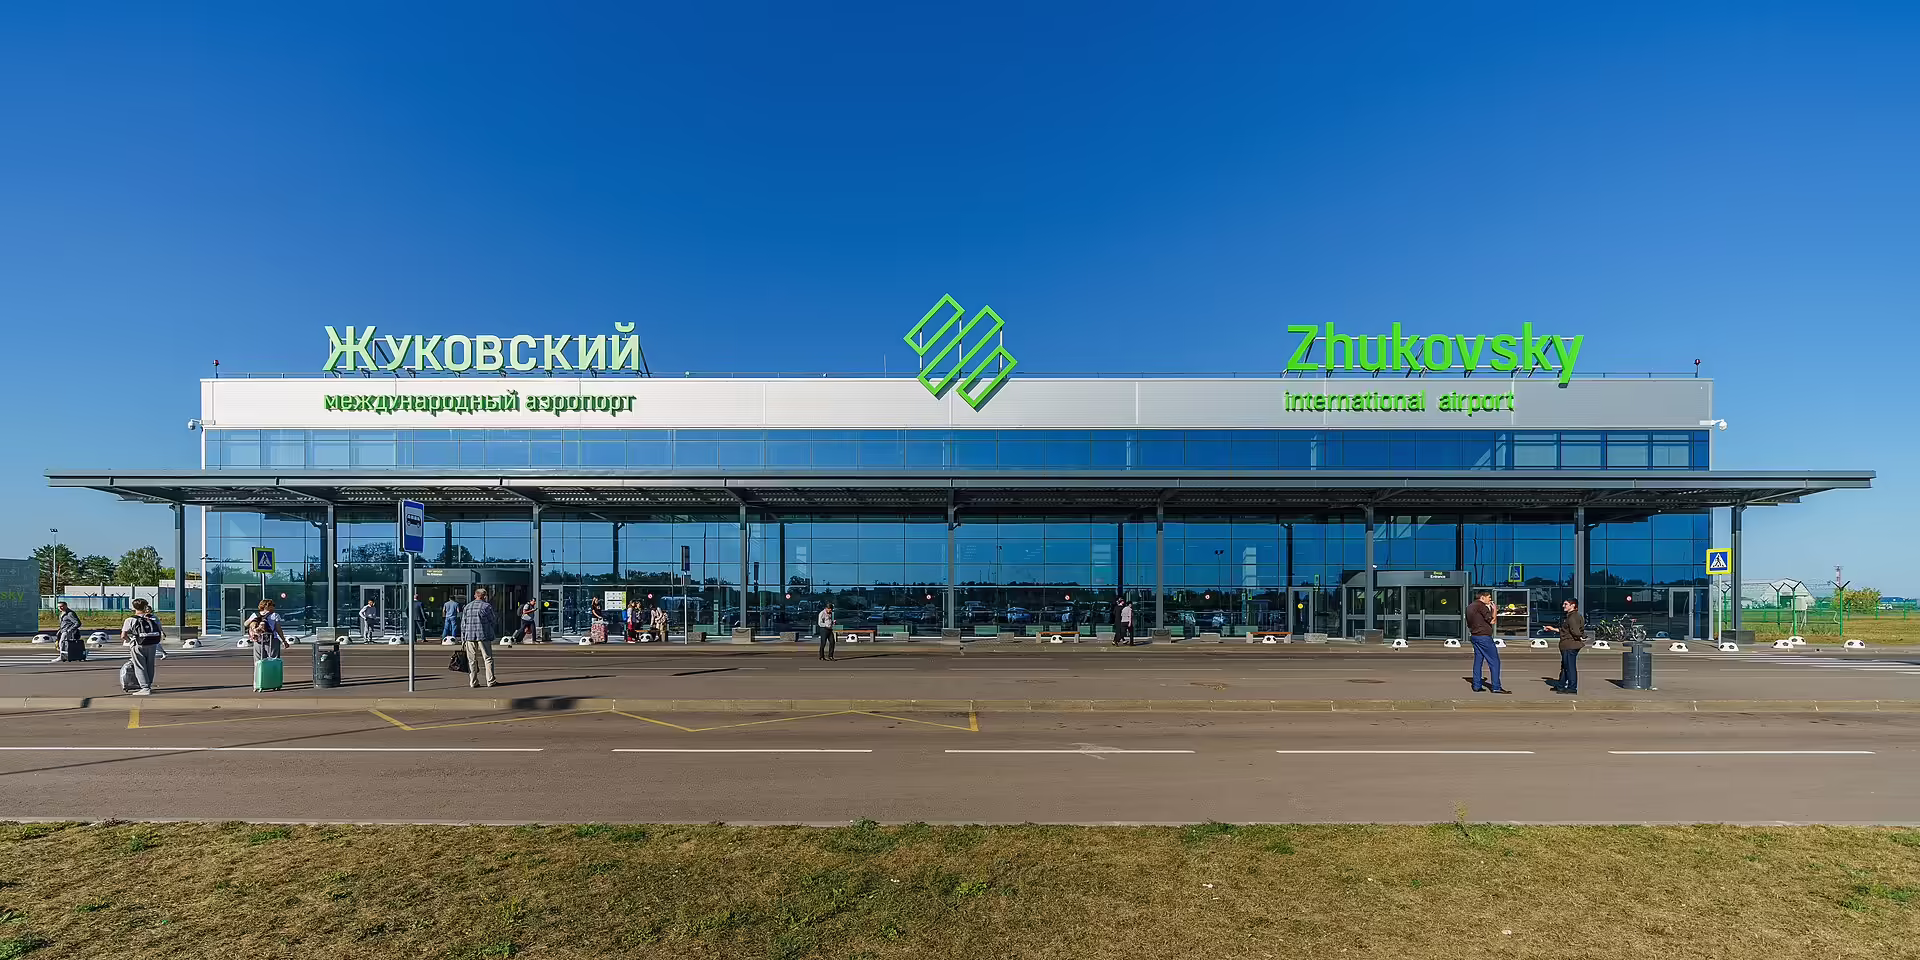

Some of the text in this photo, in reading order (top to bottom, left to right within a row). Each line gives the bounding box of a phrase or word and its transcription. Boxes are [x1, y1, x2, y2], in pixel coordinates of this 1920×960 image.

[1287, 321, 1584, 388] Zhukovsky
[323, 389, 637, 416] международный аэропорт
[1284, 390, 1515, 417] international airport
